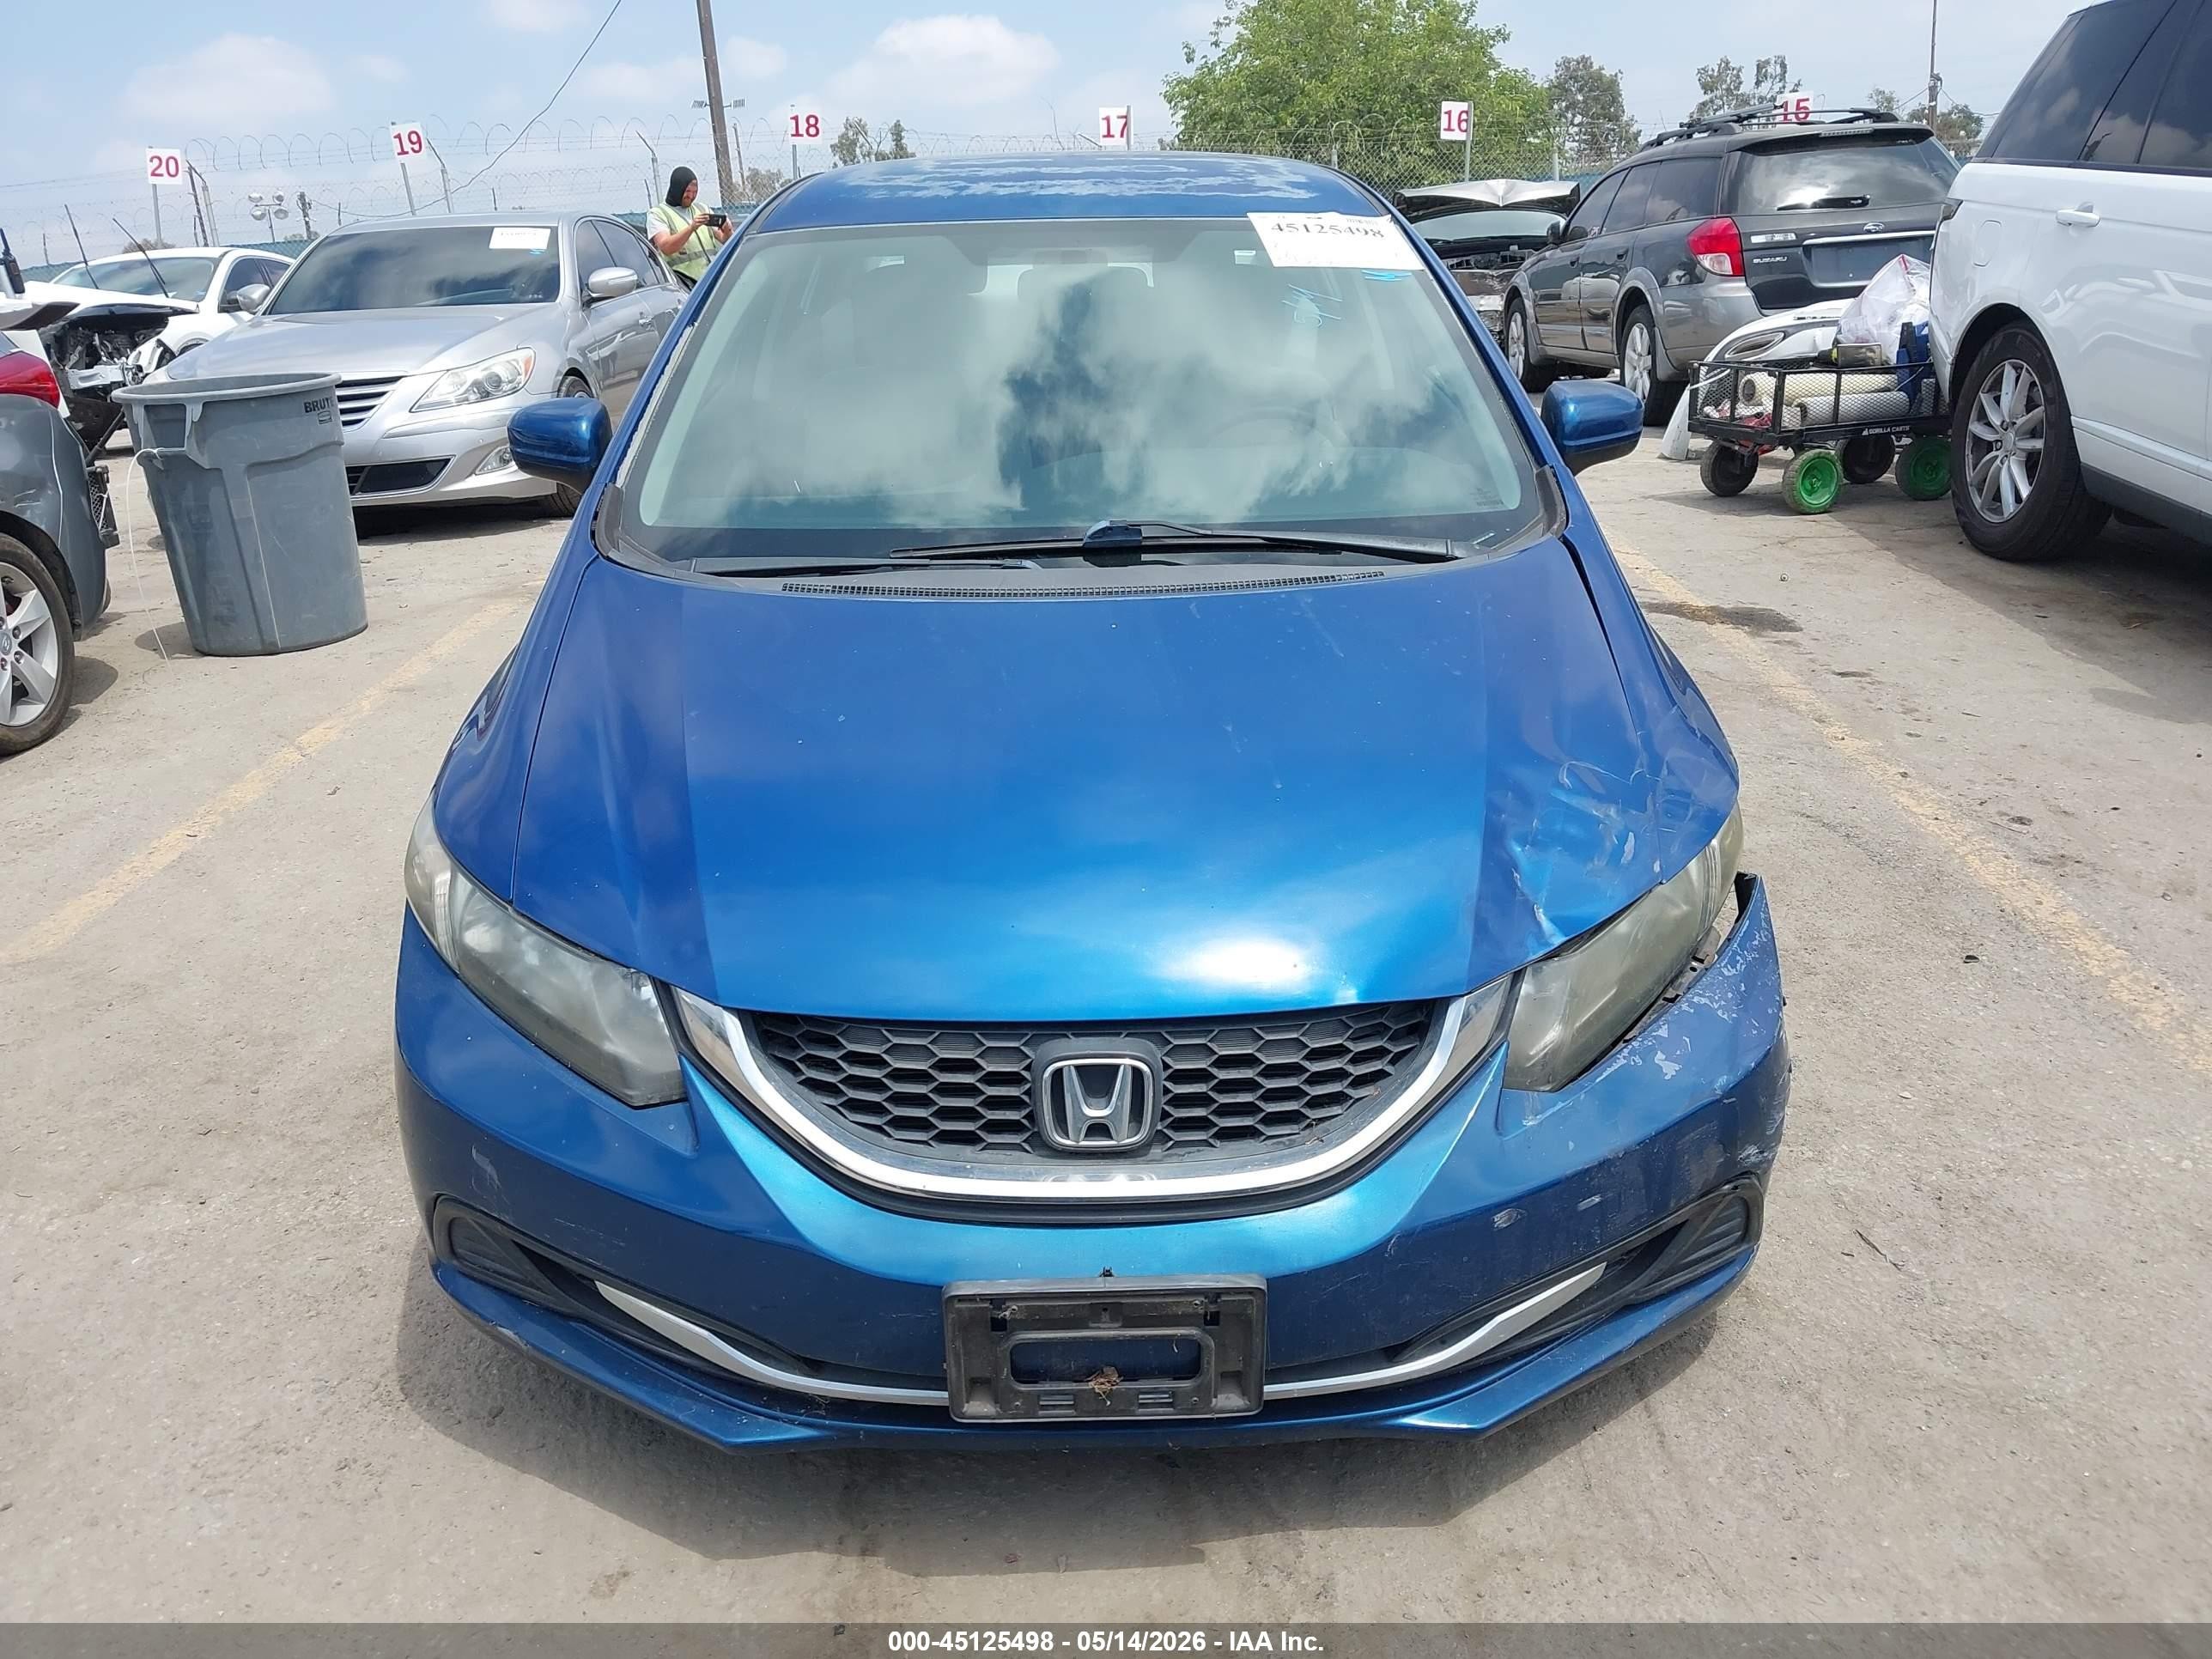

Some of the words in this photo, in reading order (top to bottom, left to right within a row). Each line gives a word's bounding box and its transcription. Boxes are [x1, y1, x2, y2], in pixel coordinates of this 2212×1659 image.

[1443, 109, 1469, 133] 16
[1779, 97, 1810, 123] 15
[789, 114, 820, 138] 18
[1101, 115, 1128, 139] 17
[392, 130, 423, 156] 19
[149, 155, 179, 178] 20
